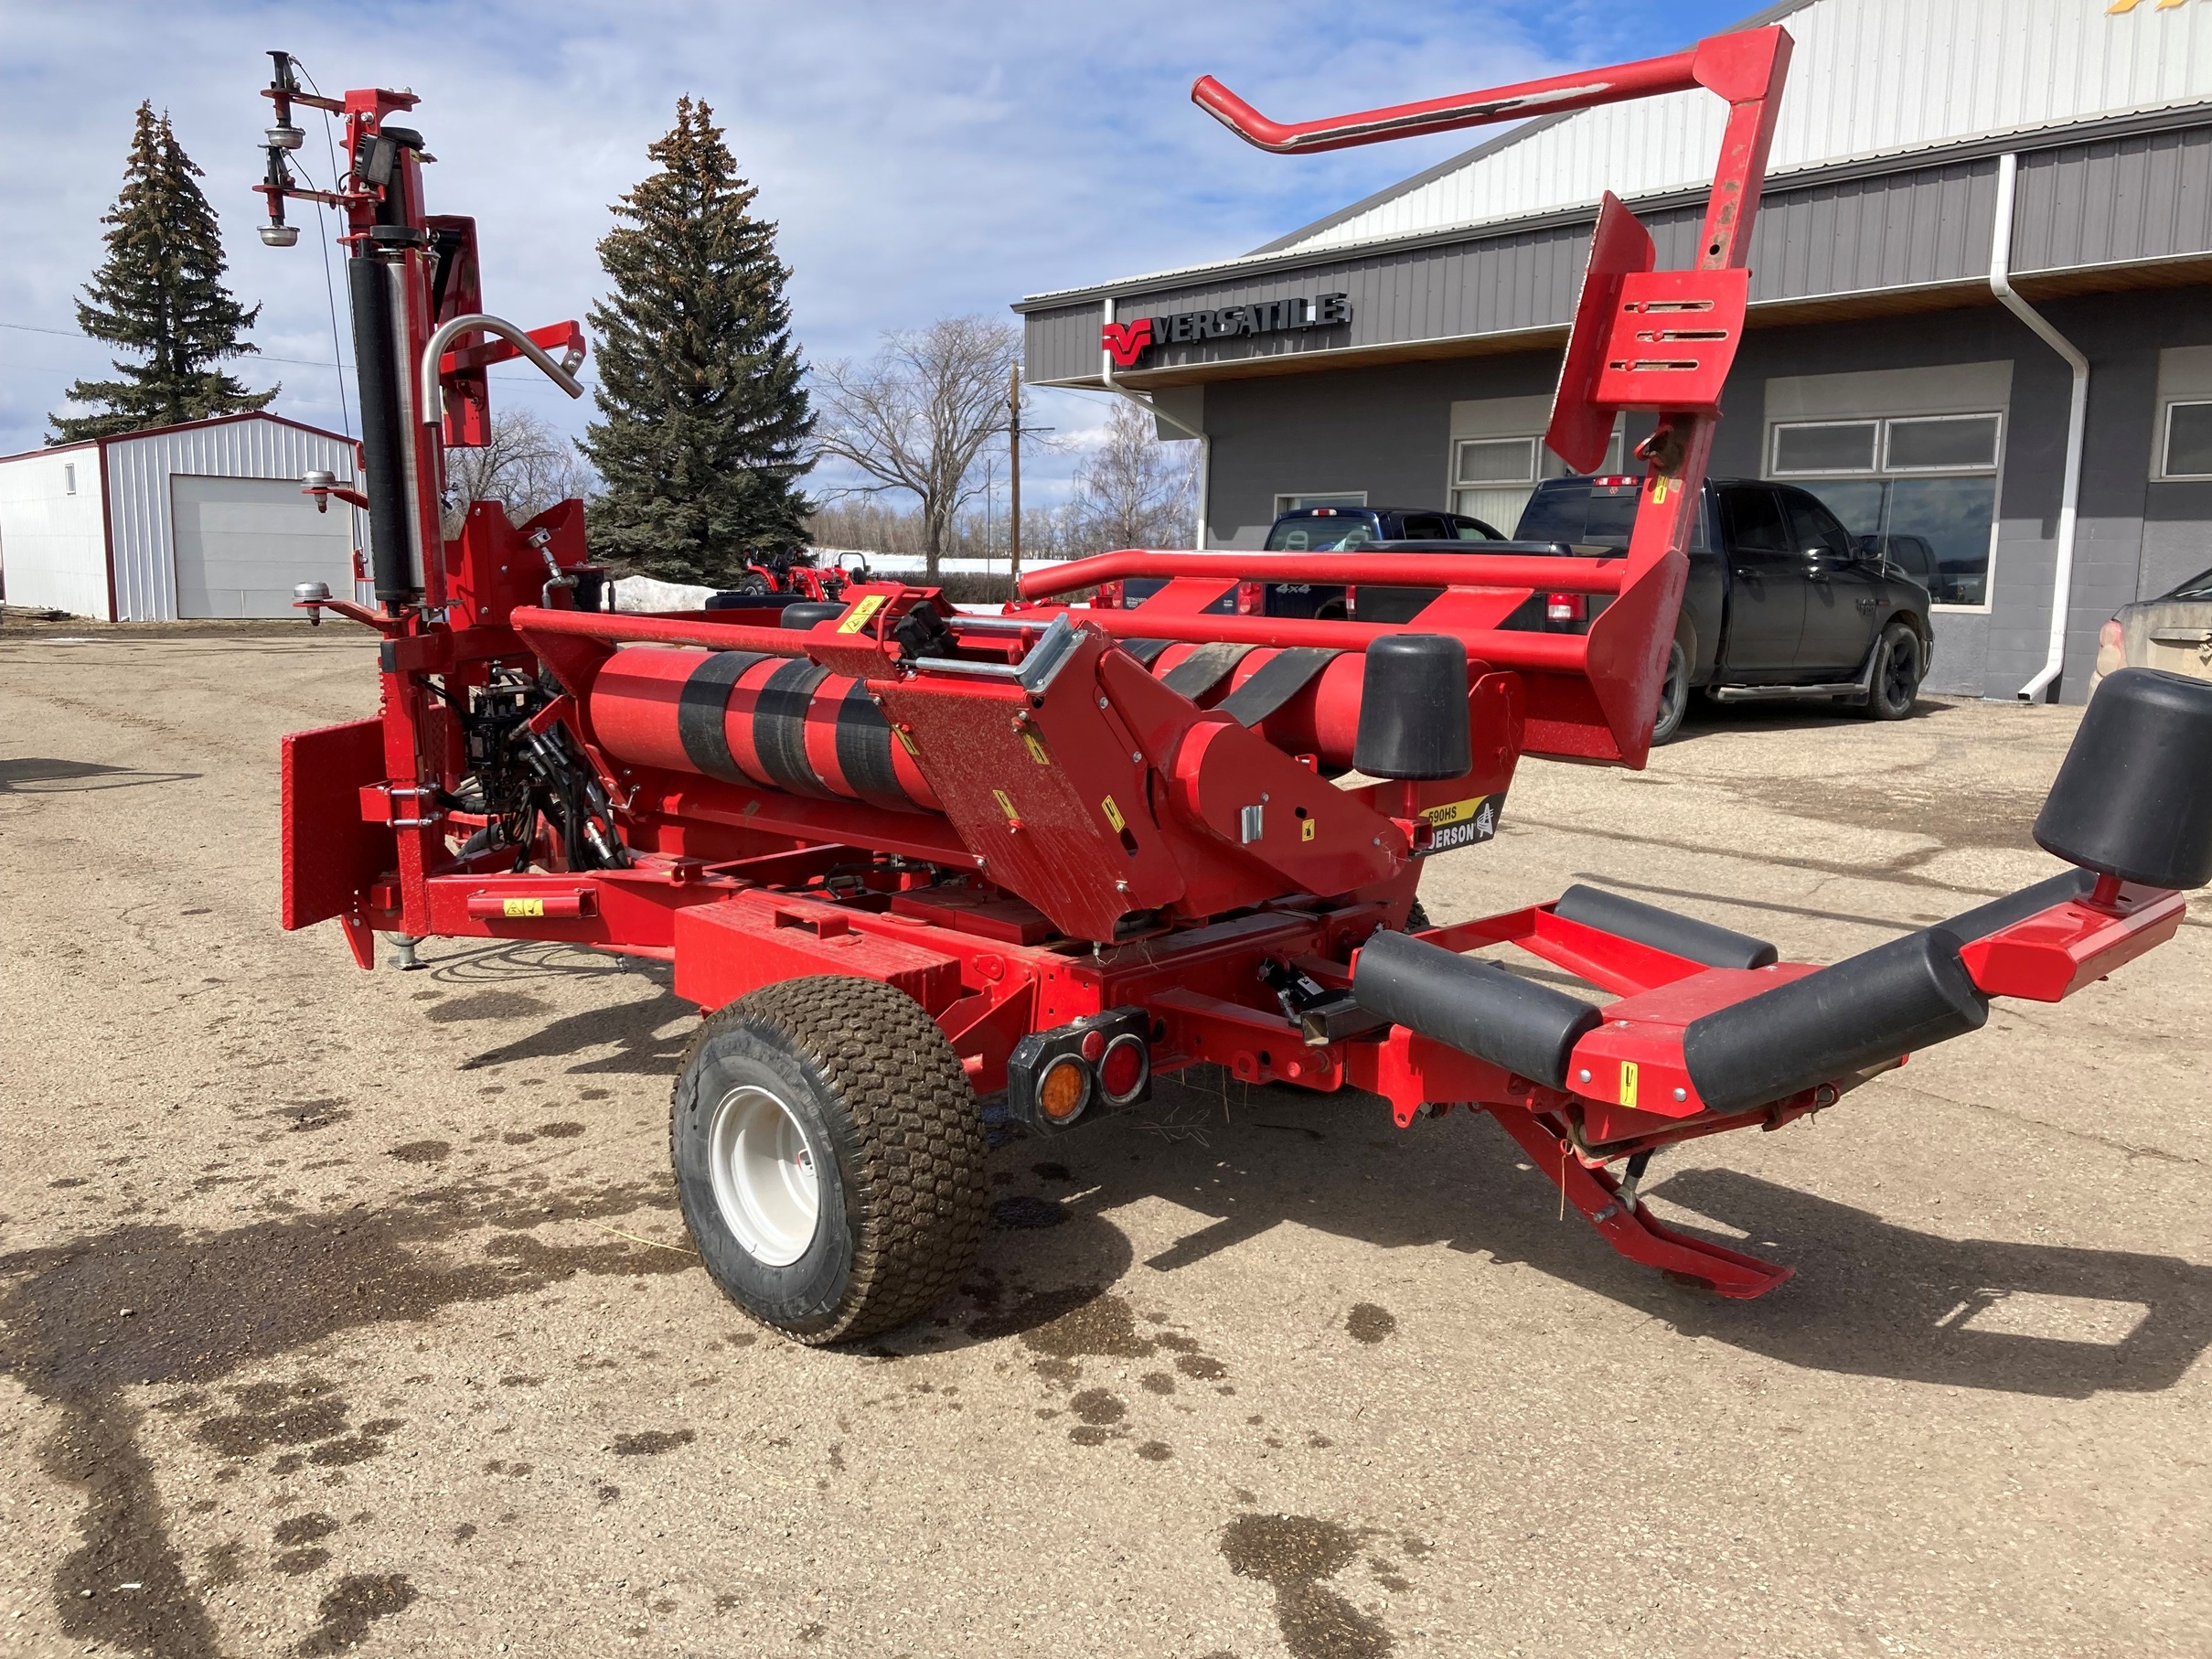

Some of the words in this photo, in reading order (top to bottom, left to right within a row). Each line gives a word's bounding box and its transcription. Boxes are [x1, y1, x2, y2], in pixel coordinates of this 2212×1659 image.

[1150, 292, 1351, 346] VERSATILE
[1276, 583, 1312, 594] 4x4
[1428, 806, 1458, 823] 590HS
